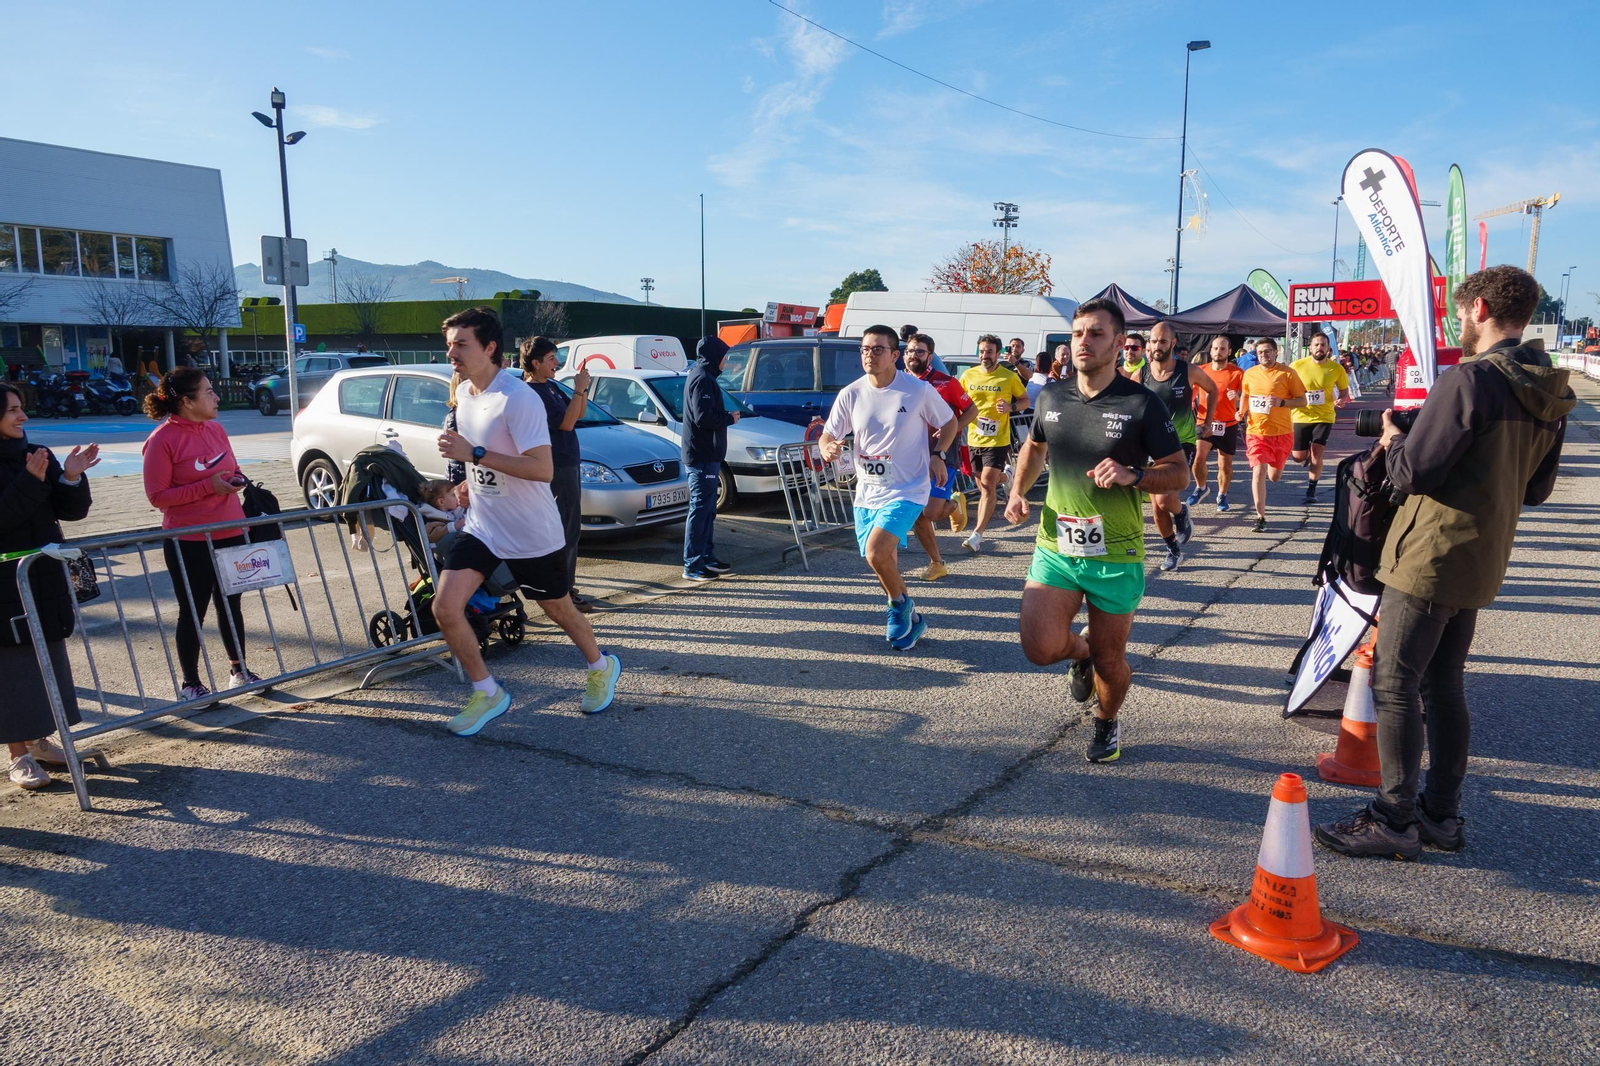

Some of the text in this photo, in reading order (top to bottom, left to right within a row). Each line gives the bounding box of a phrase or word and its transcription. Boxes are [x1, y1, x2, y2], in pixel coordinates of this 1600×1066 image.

[1369, 191, 1405, 253] DEPORTE
[1367, 212, 1394, 257] Atlántico
[1293, 287, 1334, 302] RUN
[782, 305, 794, 314] RUN
[295, 326, 303, 340] P
[976, 384, 1002, 392] ACTEGA
[1252, 400, 1266, 408] 124
[1308, 393, 1320, 401] 119
[1045, 411, 1061, 422] DK
[981, 422, 996, 433] 114
[1106, 421, 1122, 430] 2M
[1105, 430, 1122, 439] VIGO
[863, 462, 886, 476] 120
[471, 467, 498, 487] 132
[652, 489, 686, 507] 7935 BXN
[1065, 527, 1102, 545] 136
[233, 556, 270, 571] TeamRelay
